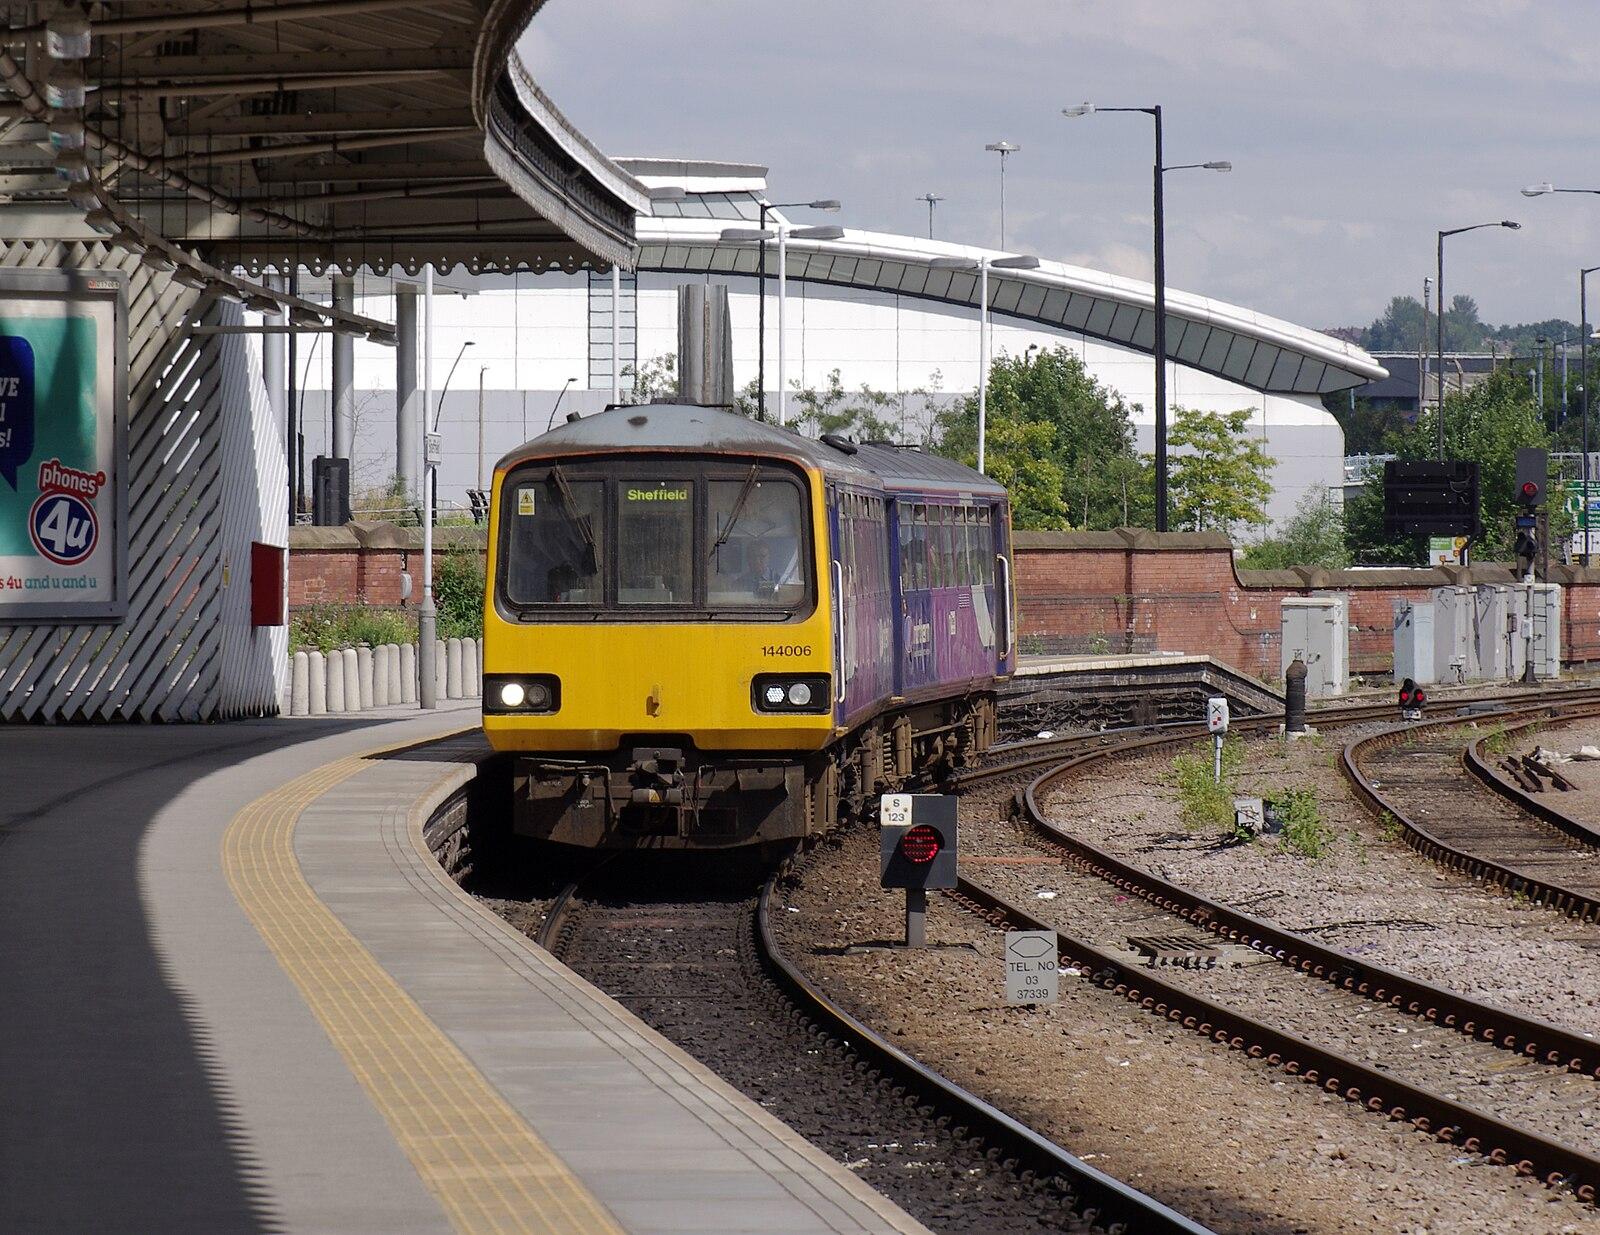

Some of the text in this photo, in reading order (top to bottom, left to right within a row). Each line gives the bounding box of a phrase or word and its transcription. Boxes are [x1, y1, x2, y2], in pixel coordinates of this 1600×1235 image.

[42, 465, 97, 495] phones
[627, 489, 689, 501] Sheffield
[40, 500, 91, 554] 4u
[7, 575, 22, 589] 4u
[24, 575, 50, 589] and
[52, 577, 60, 589] u
[62, 575, 87, 588] and
[89, 577, 97, 588] u
[761, 645, 812, 657] 144006
[893, 798, 901, 807] S
[888, 812, 905, 822] 123
[1038, 961, 1056, 971] NO
[1025, 975, 1039, 985] 03
[1016, 988, 1049, 999] 37339
